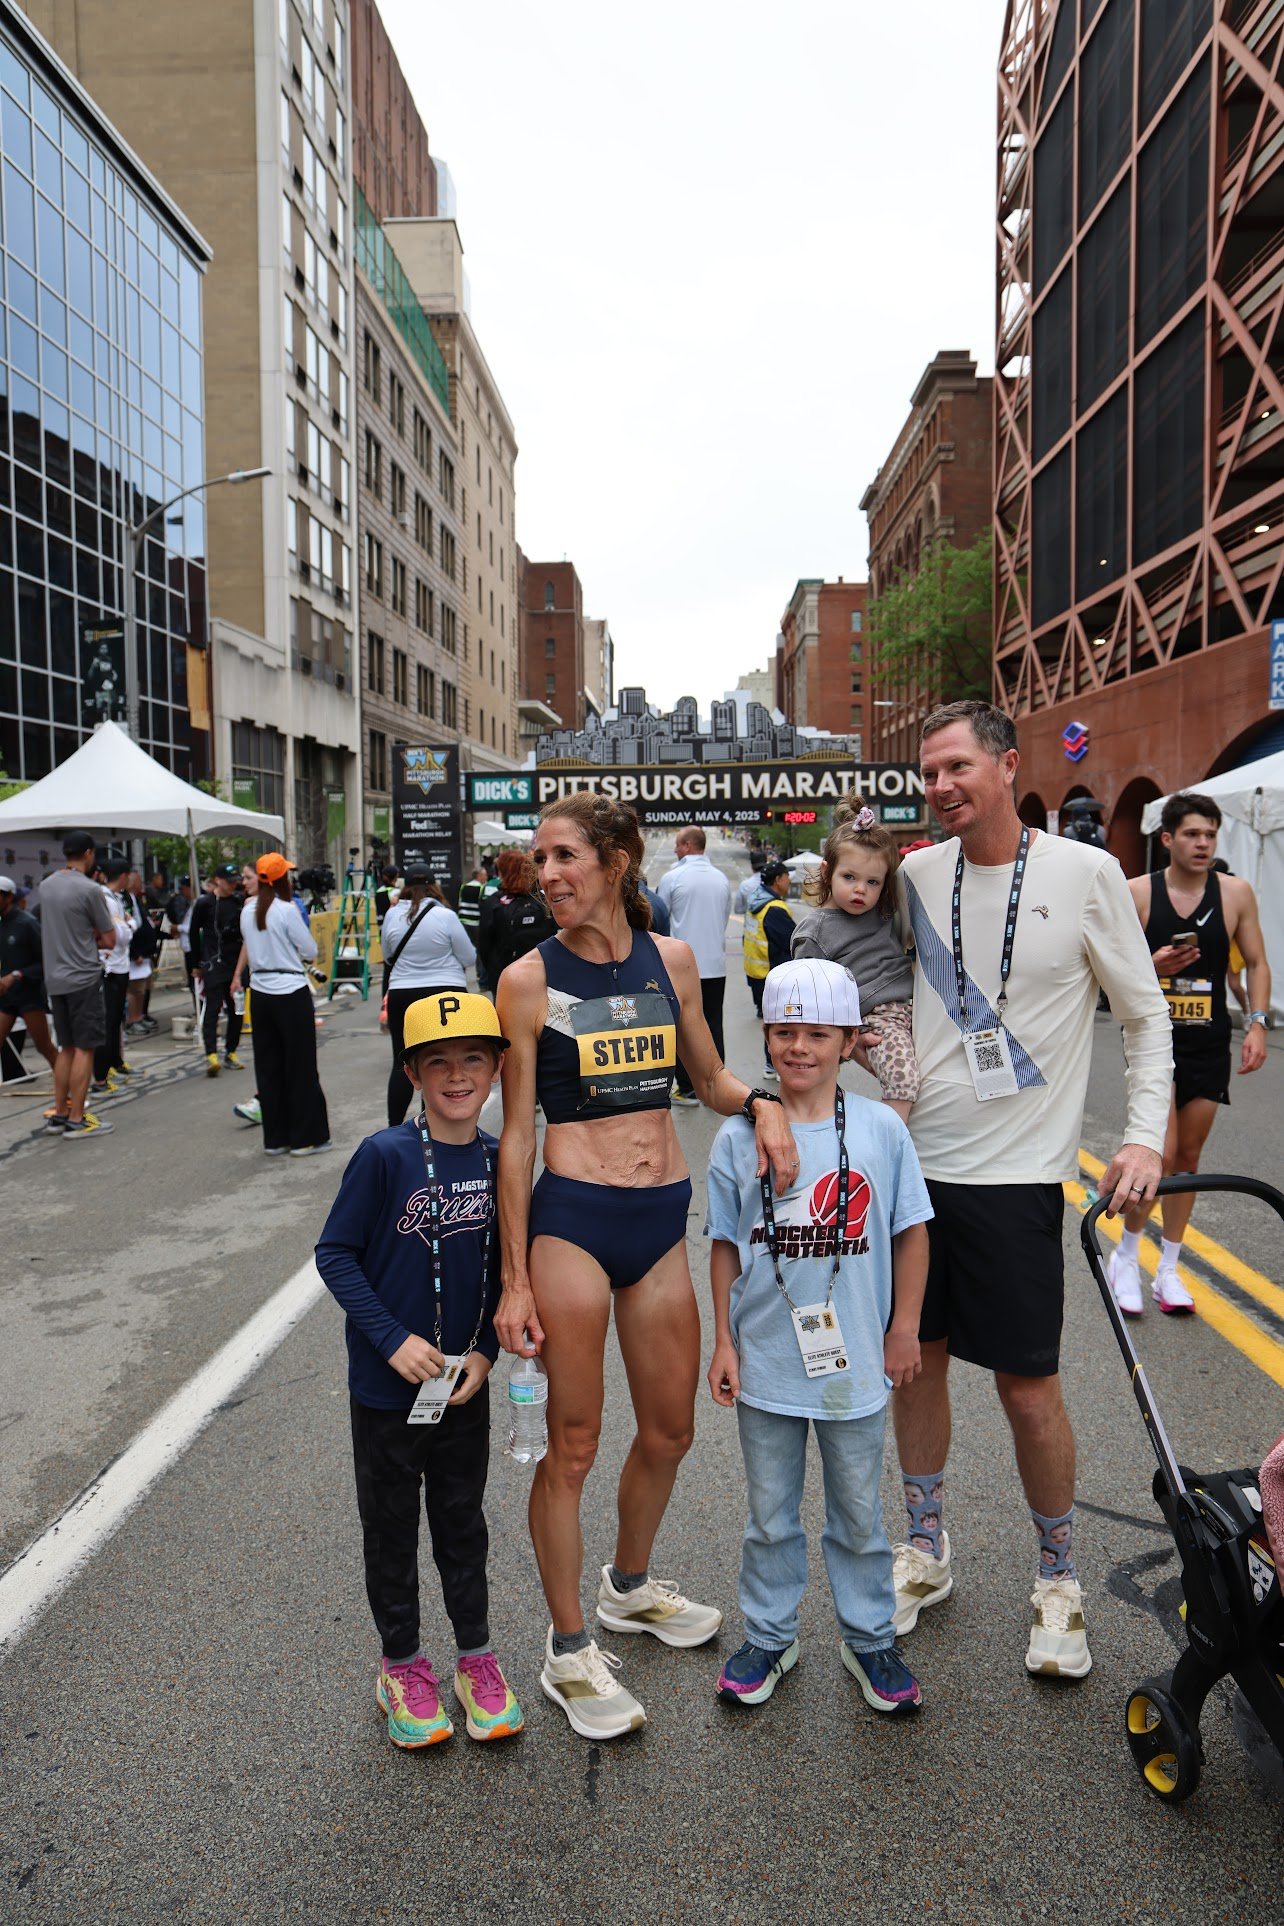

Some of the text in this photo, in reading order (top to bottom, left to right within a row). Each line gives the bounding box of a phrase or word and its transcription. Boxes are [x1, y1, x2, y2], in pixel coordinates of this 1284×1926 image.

[474, 778, 529, 801] DICK'S
[539, 769, 924, 802] PITTSBURGH MARATHON
[645, 810, 760, 824] SUNDAY, MAY 4, 2025
[883, 806, 916, 820] DICK'S
[438, 996, 460, 1026] P
[593, 1034, 665, 1067] STEPH
[451, 1179, 489, 1194] FLAGSTAF
